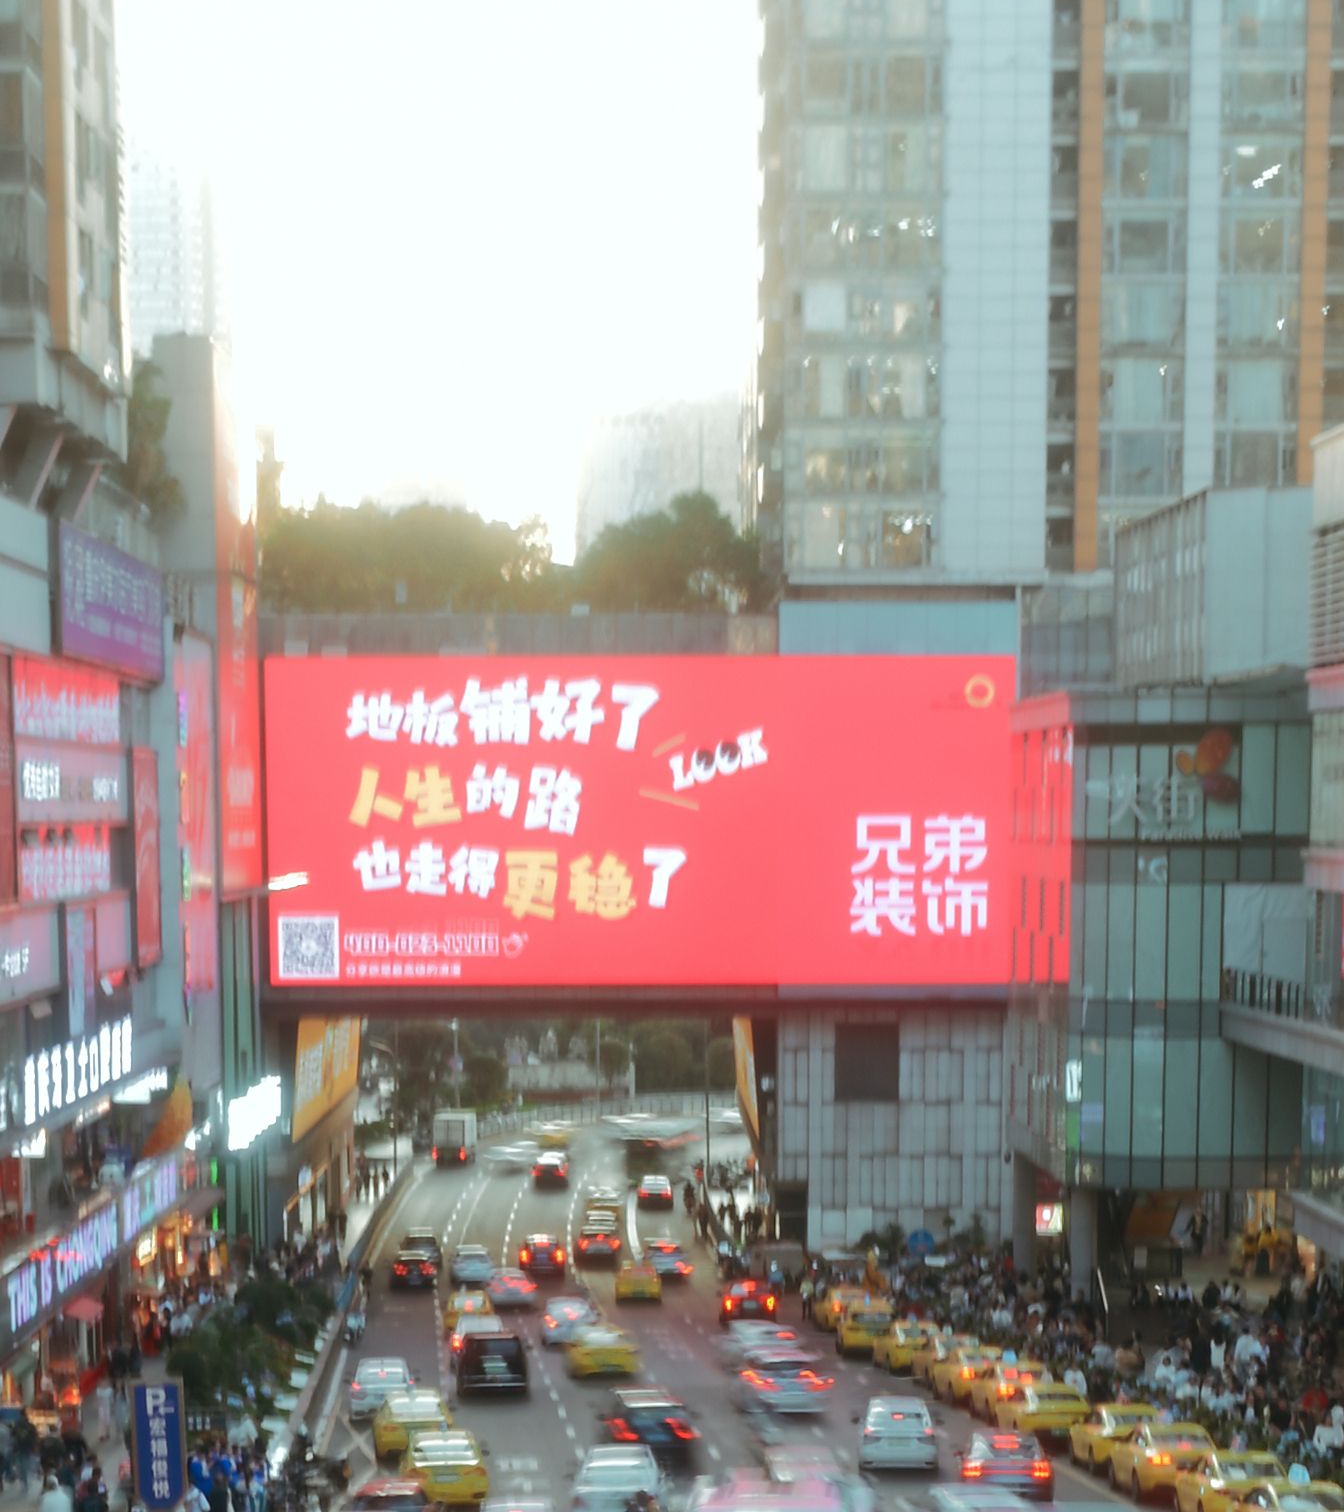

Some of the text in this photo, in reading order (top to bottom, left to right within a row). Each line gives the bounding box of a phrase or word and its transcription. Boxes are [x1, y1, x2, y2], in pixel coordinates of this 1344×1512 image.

[346, 676, 659, 751] 地板铺好了
[349, 761, 582, 835] 人生的路
[353, 836, 687, 920] 也走得更稳了
[850, 813, 988, 874] 兄弟
[849, 876, 989, 937] 装饰
